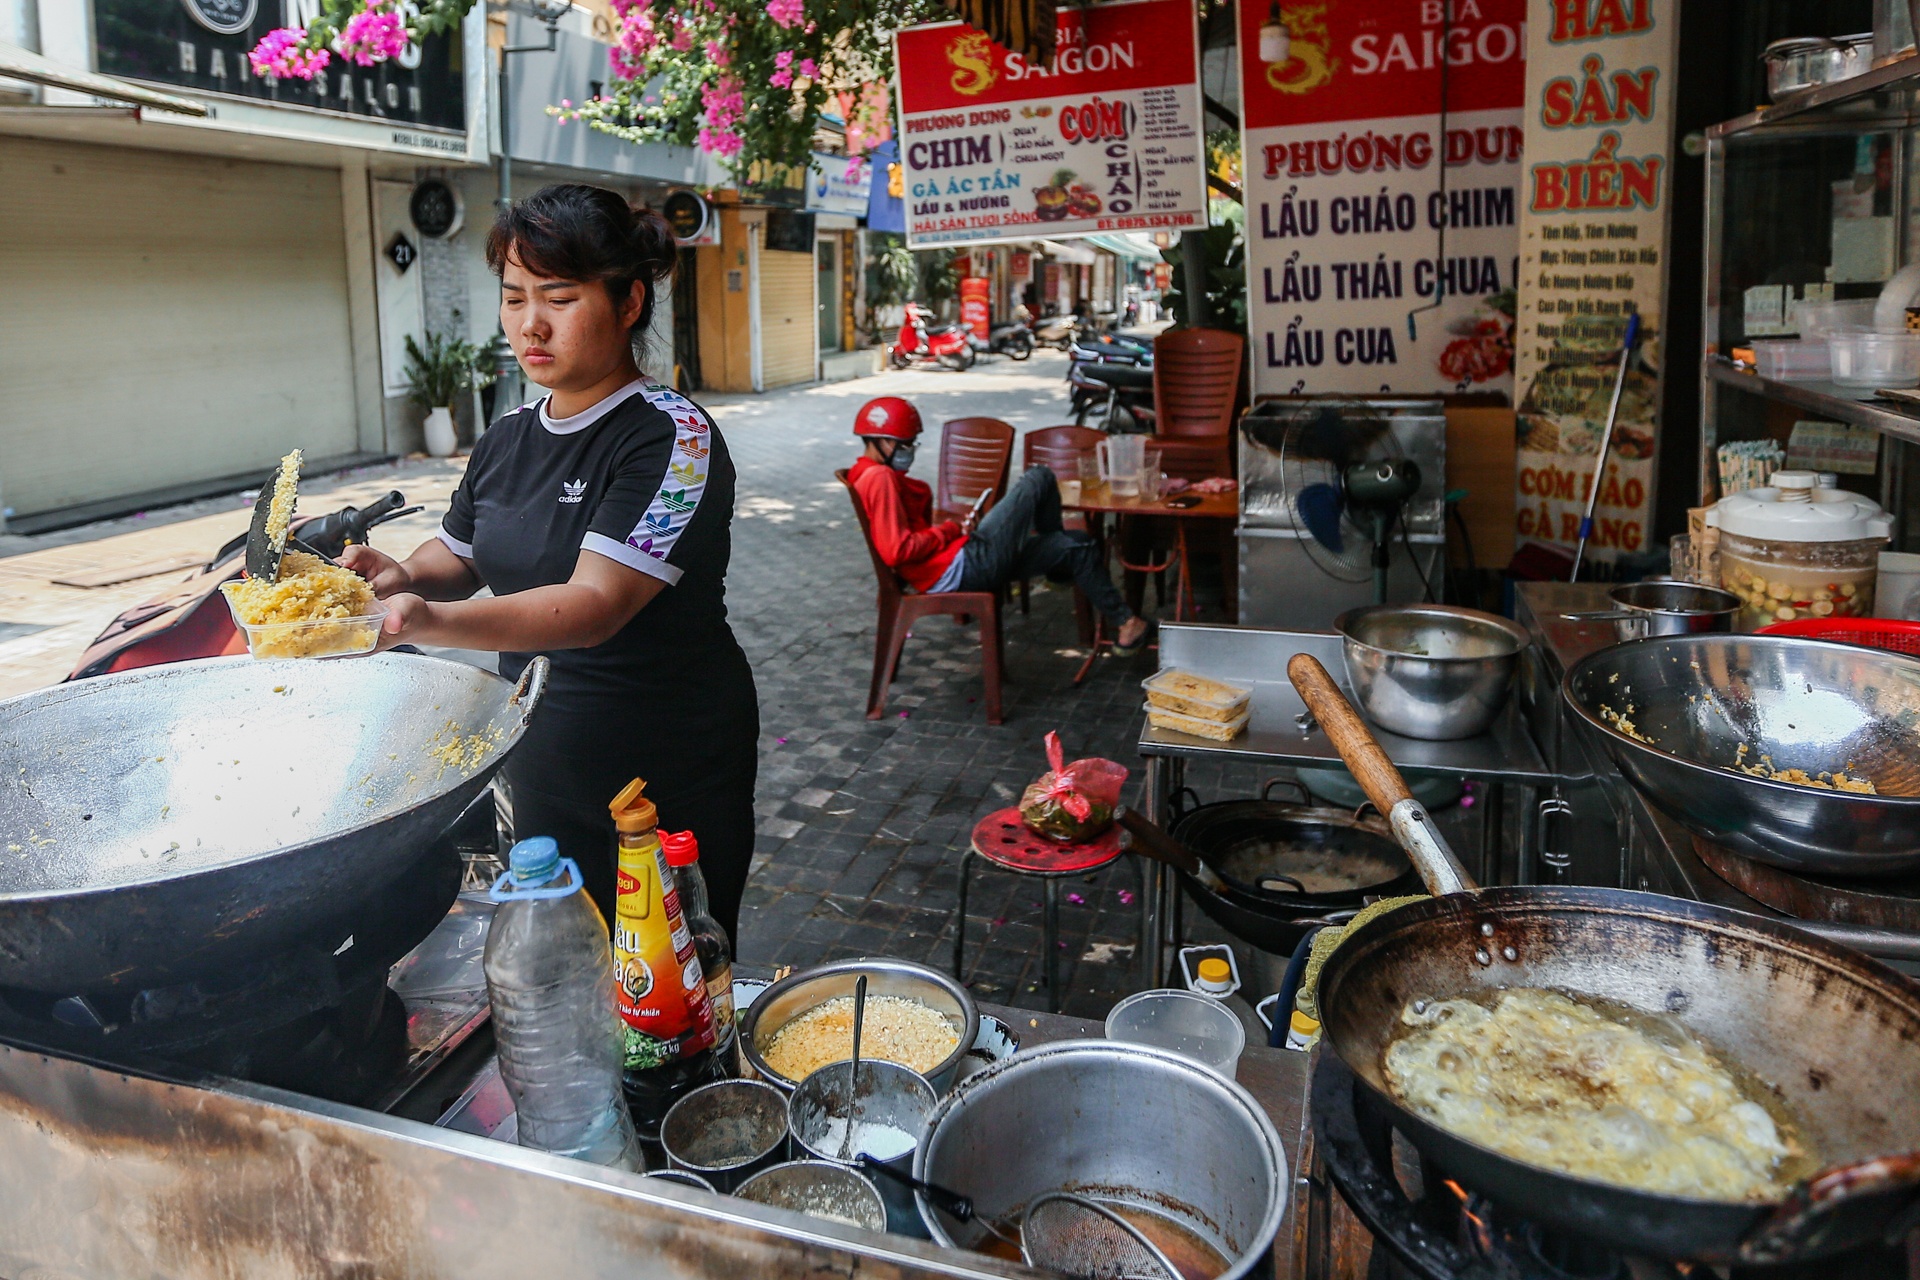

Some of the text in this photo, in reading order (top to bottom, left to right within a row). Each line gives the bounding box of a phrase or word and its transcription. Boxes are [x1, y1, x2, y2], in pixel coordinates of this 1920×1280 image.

[1421, 0, 1483, 26] BIA
[1351, 23, 1527, 75] SAIGO
[312, 69, 422, 111] SALON
[1542, 54, 1658, 128] SẢN
[969, 108, 1012, 127] DUNG
[1012, 126, 1037, 137] QUAY
[1059, 95, 1128, 143] CƠM
[907, 134, 993, 171] CHIM
[1014, 155, 1039, 164] CHUA
[1264, 130, 1433, 179] PHƯƠNG
[912, 178, 940, 198] GÀ
[946, 175, 974, 195] ÁC
[1530, 133, 1664, 214] BIỂN
[944, 202, 954, 213] &
[1261, 184, 1515, 239] LẨU CHÁO CHIM
[395, 244, 411, 264] 21
[1263, 250, 1322, 304] LẨU
[1331, 252, 1403, 301] THÁI
[1414, 255, 1501, 298] CHUA
[1266, 314, 1398, 368] LẨU CUA
[1519, 463, 1577, 502] CƠM
[668, 1043, 681, 1054] kg
